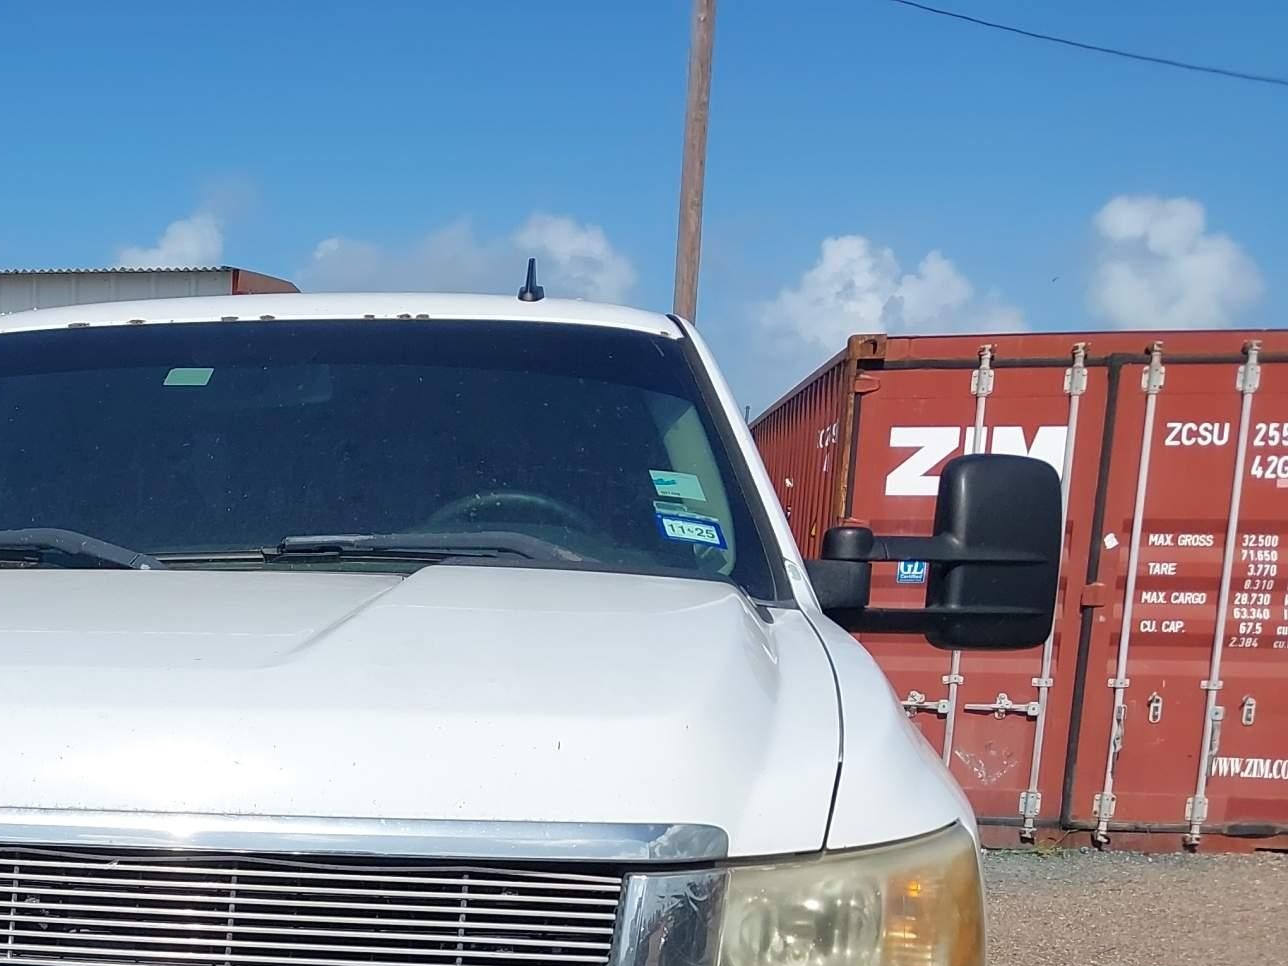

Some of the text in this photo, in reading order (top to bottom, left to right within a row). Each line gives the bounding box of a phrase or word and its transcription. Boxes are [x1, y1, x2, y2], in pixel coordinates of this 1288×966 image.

[1164, 422, 1231, 446] ZCSU
[1177, 534, 1214, 547] GROSS
[1242, 535, 1279, 547] 32.500
[1241, 549, 1278, 562] 71.650
[1148, 562, 1277, 577] TARE 3.770
[1243, 579, 1275, 590] 8.310
[1170, 592, 1208, 604] CARGO
[1233, 593, 1271, 606] 28.730
[1233, 608, 1271, 620] 63.340
[1139, 620, 1158, 633] CU.
[1161, 620, 1186, 633] CAP.
[1239, 622, 1263, 635] 67.5
[1228, 637, 1260, 648] 2.384
